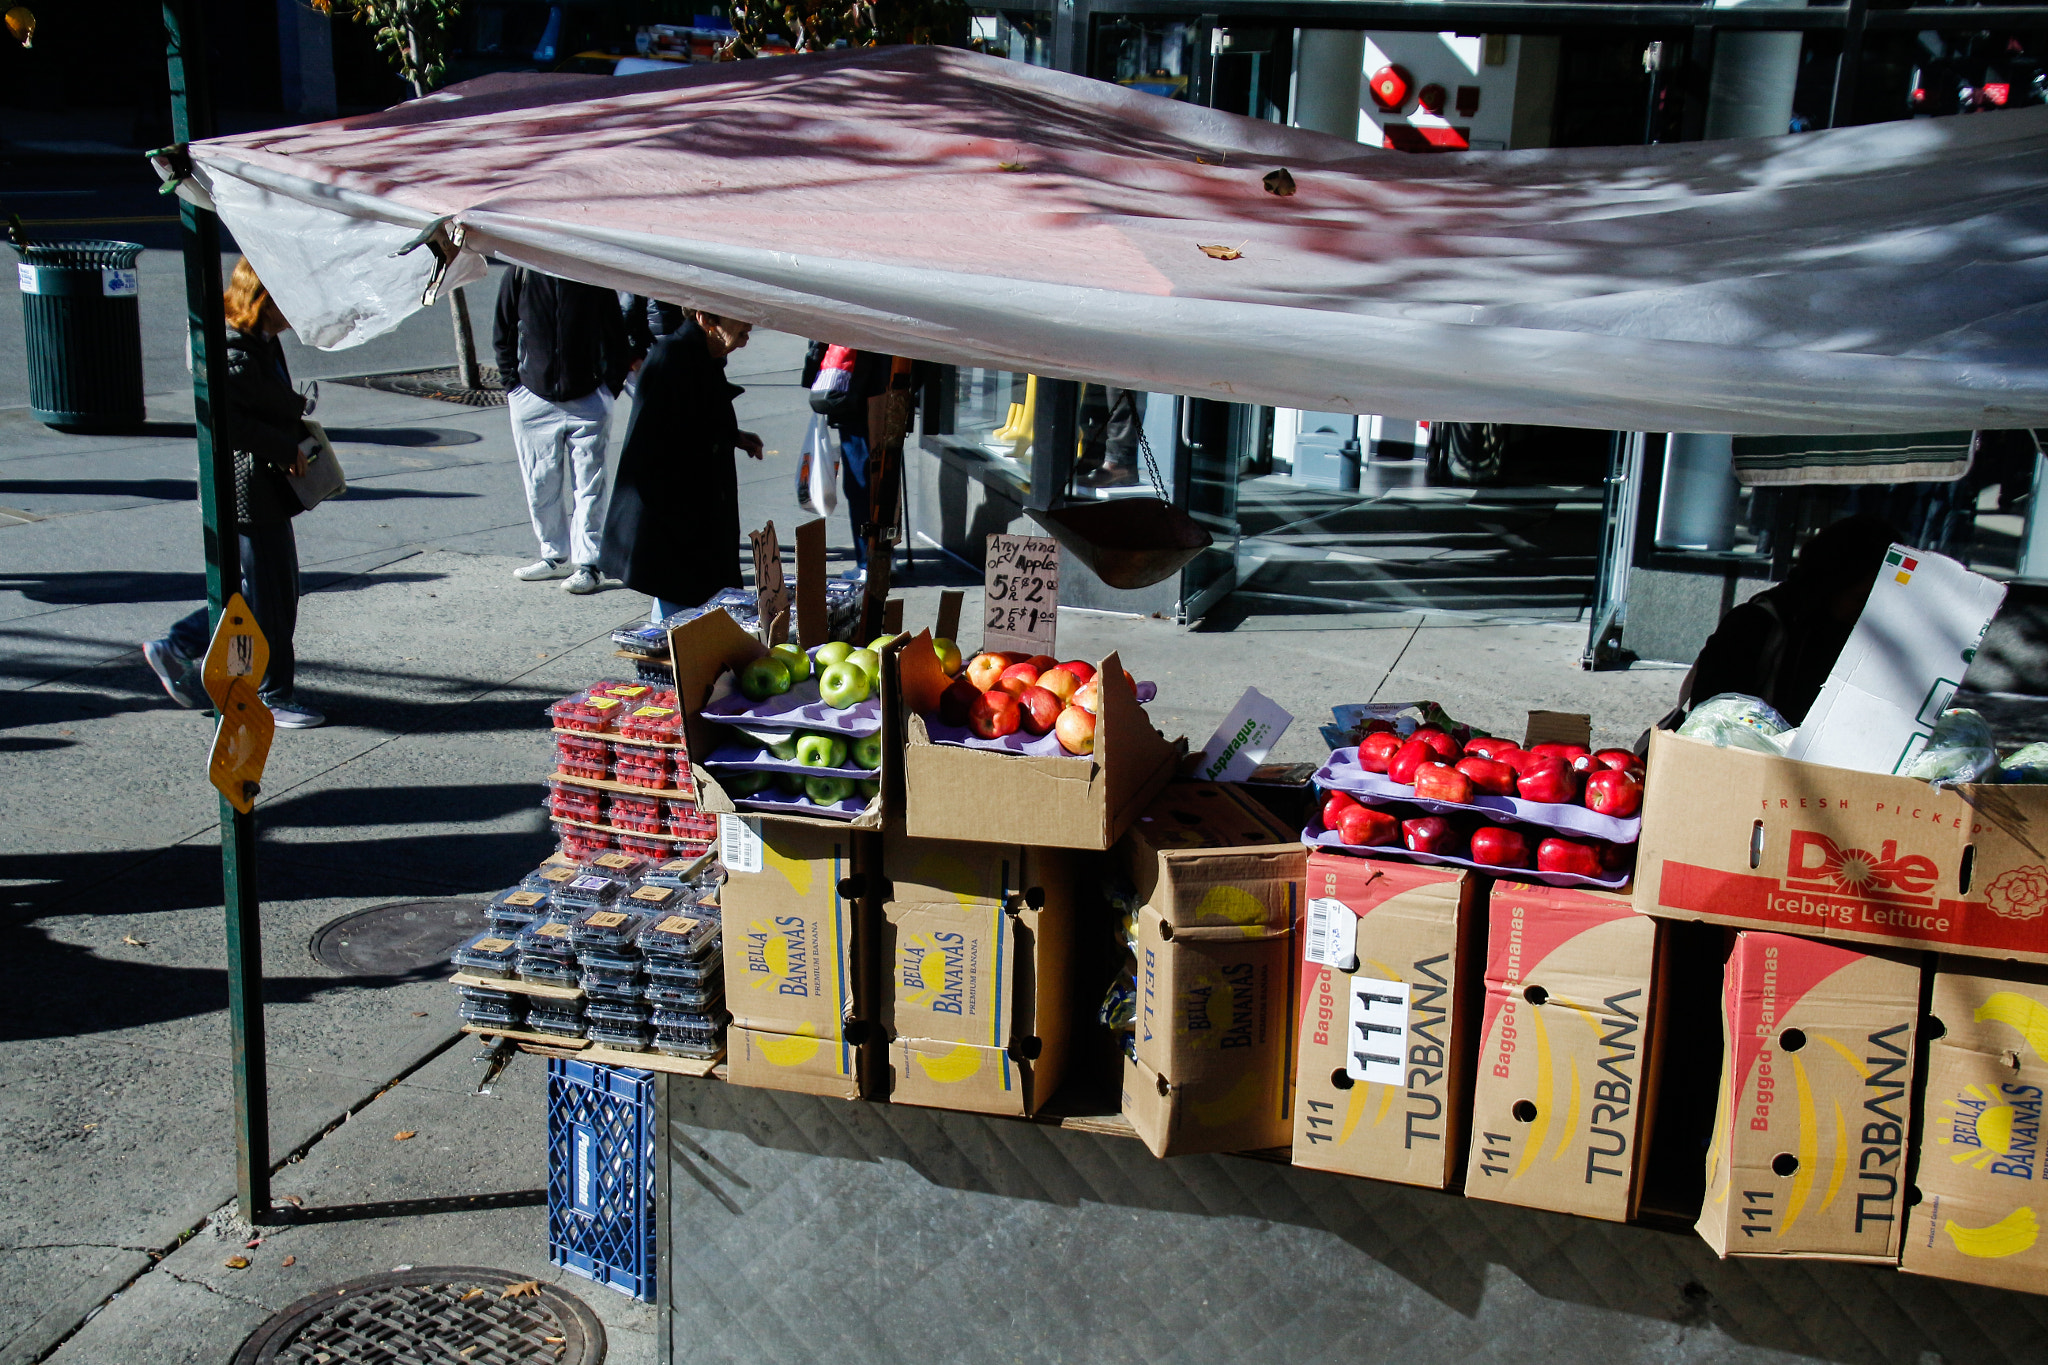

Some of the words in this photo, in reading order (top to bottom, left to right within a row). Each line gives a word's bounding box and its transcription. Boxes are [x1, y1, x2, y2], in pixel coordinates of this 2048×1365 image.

[990, 536, 1019, 563] Any
[988, 574, 1008, 600] 5
[1008, 576, 1021, 601] FOR
[987, 607, 1004, 629] 2
[1007, 608, 1019, 631] FOR
[1206, 718, 1257, 780] Asparagus
[1761, 798, 1849, 810] FRESH
[1876, 802, 1982, 834] PICKED
[1785, 829, 1940, 894] Dole
[812, 921, 820, 957] BANANA
[1767, 893, 1855, 924] Iceberg
[1861, 903, 1950, 932] Lettuce
[748, 931, 770, 973] BELLA
[775, 916, 808, 998] BANANAS
[903, 947, 926, 989] BELLA
[933, 931, 965, 1016] BANANAS
[970, 938, 978, 974] BANANA
[1501, 906, 1525, 990] Bananas
[813, 958, 821, 997] PREMIUM
[969, 976, 977, 1015] PREMIUM
[1144, 947, 1154, 1042] BELLA
[1755, 946, 1779, 1038] Bananas
[1188, 986, 1212, 1031] BELLA
[1220, 963, 1253, 1050] BANANAS
[1313, 969, 1334, 1046] Bagged
[1353, 991, 1403, 1072] 111
[1404, 953, 1449, 1150] TURBANA
[1492, 999, 1518, 1079] Bagged
[1584, 988, 1642, 1184] TURBANA
[1750, 1050, 1775, 1132] Bagged
[1305, 1099, 1334, 1145] 111
[1854, 1022, 1910, 1233] TURBANA
[1953, 1098, 1987, 1148] BELLA
[1990, 1082, 2044, 1180] BANANAS
[1479, 1131, 1512, 1177] 111
[1740, 1189, 1774, 1238] 111
